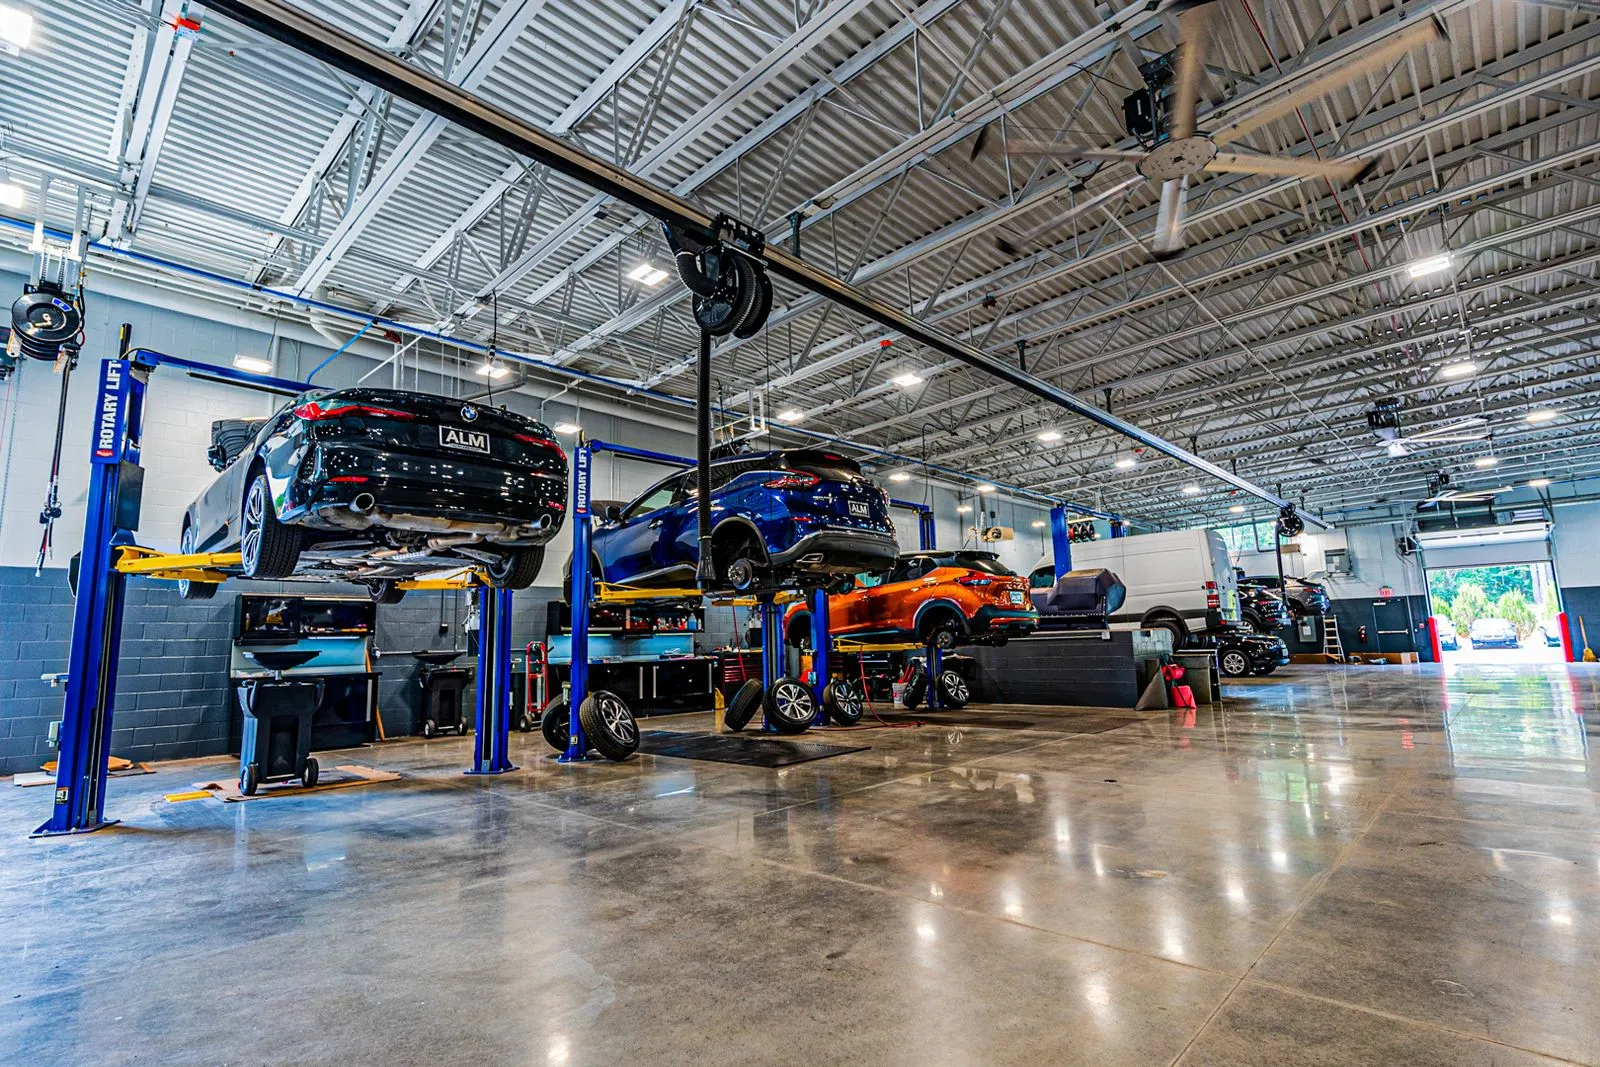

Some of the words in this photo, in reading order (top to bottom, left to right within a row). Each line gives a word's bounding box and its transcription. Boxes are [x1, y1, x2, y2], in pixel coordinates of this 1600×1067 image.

[105, 360, 122, 389] LIFT
[99, 393, 118, 449] ROTARY
[445, 430, 485, 448] ALM
[578, 448, 587, 468] LIFT
[577, 470, 587, 508] ROTARY
[851, 504, 868, 515] ALM
